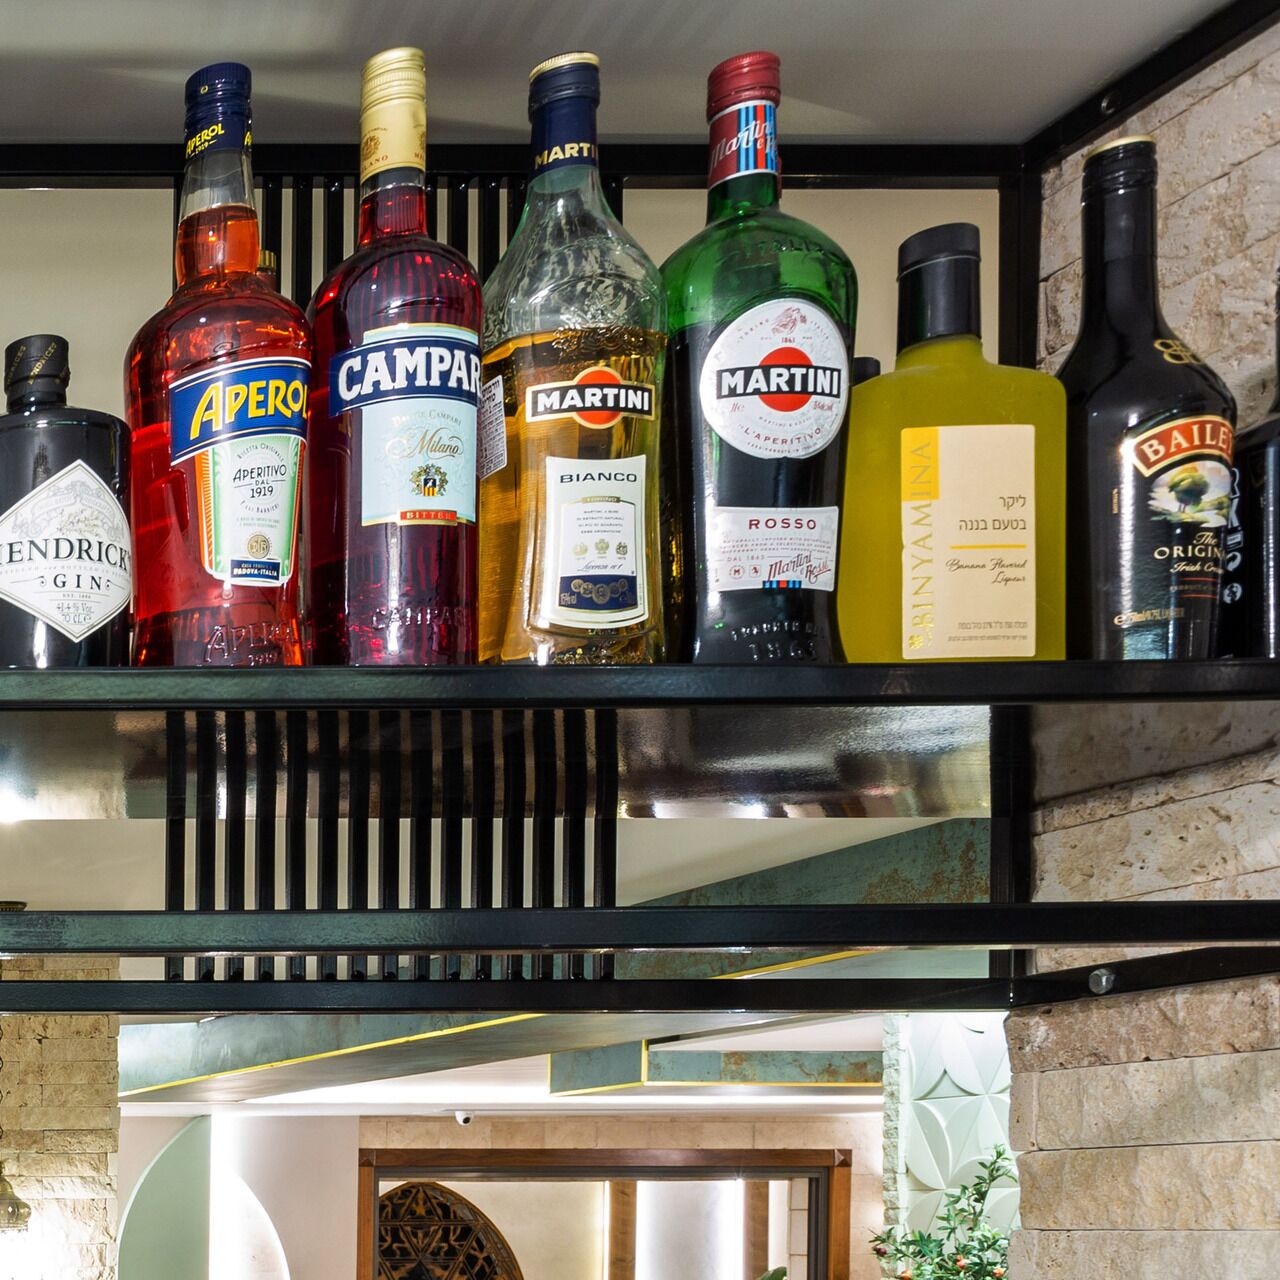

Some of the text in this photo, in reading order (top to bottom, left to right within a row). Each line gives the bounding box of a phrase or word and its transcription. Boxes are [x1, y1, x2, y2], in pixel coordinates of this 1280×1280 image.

[186, 123, 225, 159] APEROL
[720, 367, 839, 396] MARTINI
[537, 387, 649, 412] MARTINI
[190, 379, 310, 441] APEROL
[400, 427, 464, 459] Milano
[744, 427, 822, 446] L'APERITIVO
[232, 464, 288, 483] APERITIVO
[560, 472, 638, 484] BIANCO
[250, 486, 274, 498] 1919
[998, 494, 1026, 511] ליקר
[406, 511, 452, 520] BITTER
[748, 518, 817, 531] ROSSO
[958, 518, 1027, 531] בטעם בננה
[910, 441, 934, 628] BINYAMINA
[1192, 531, 1219, 546] The
[767, 550, 813, 582] Martini
[945, 558, 987, 571] Banana
[1170, 561, 1202, 574] Irish
[53, 573, 102, 591] GIN
[991, 570, 1026, 587] Liqueur
